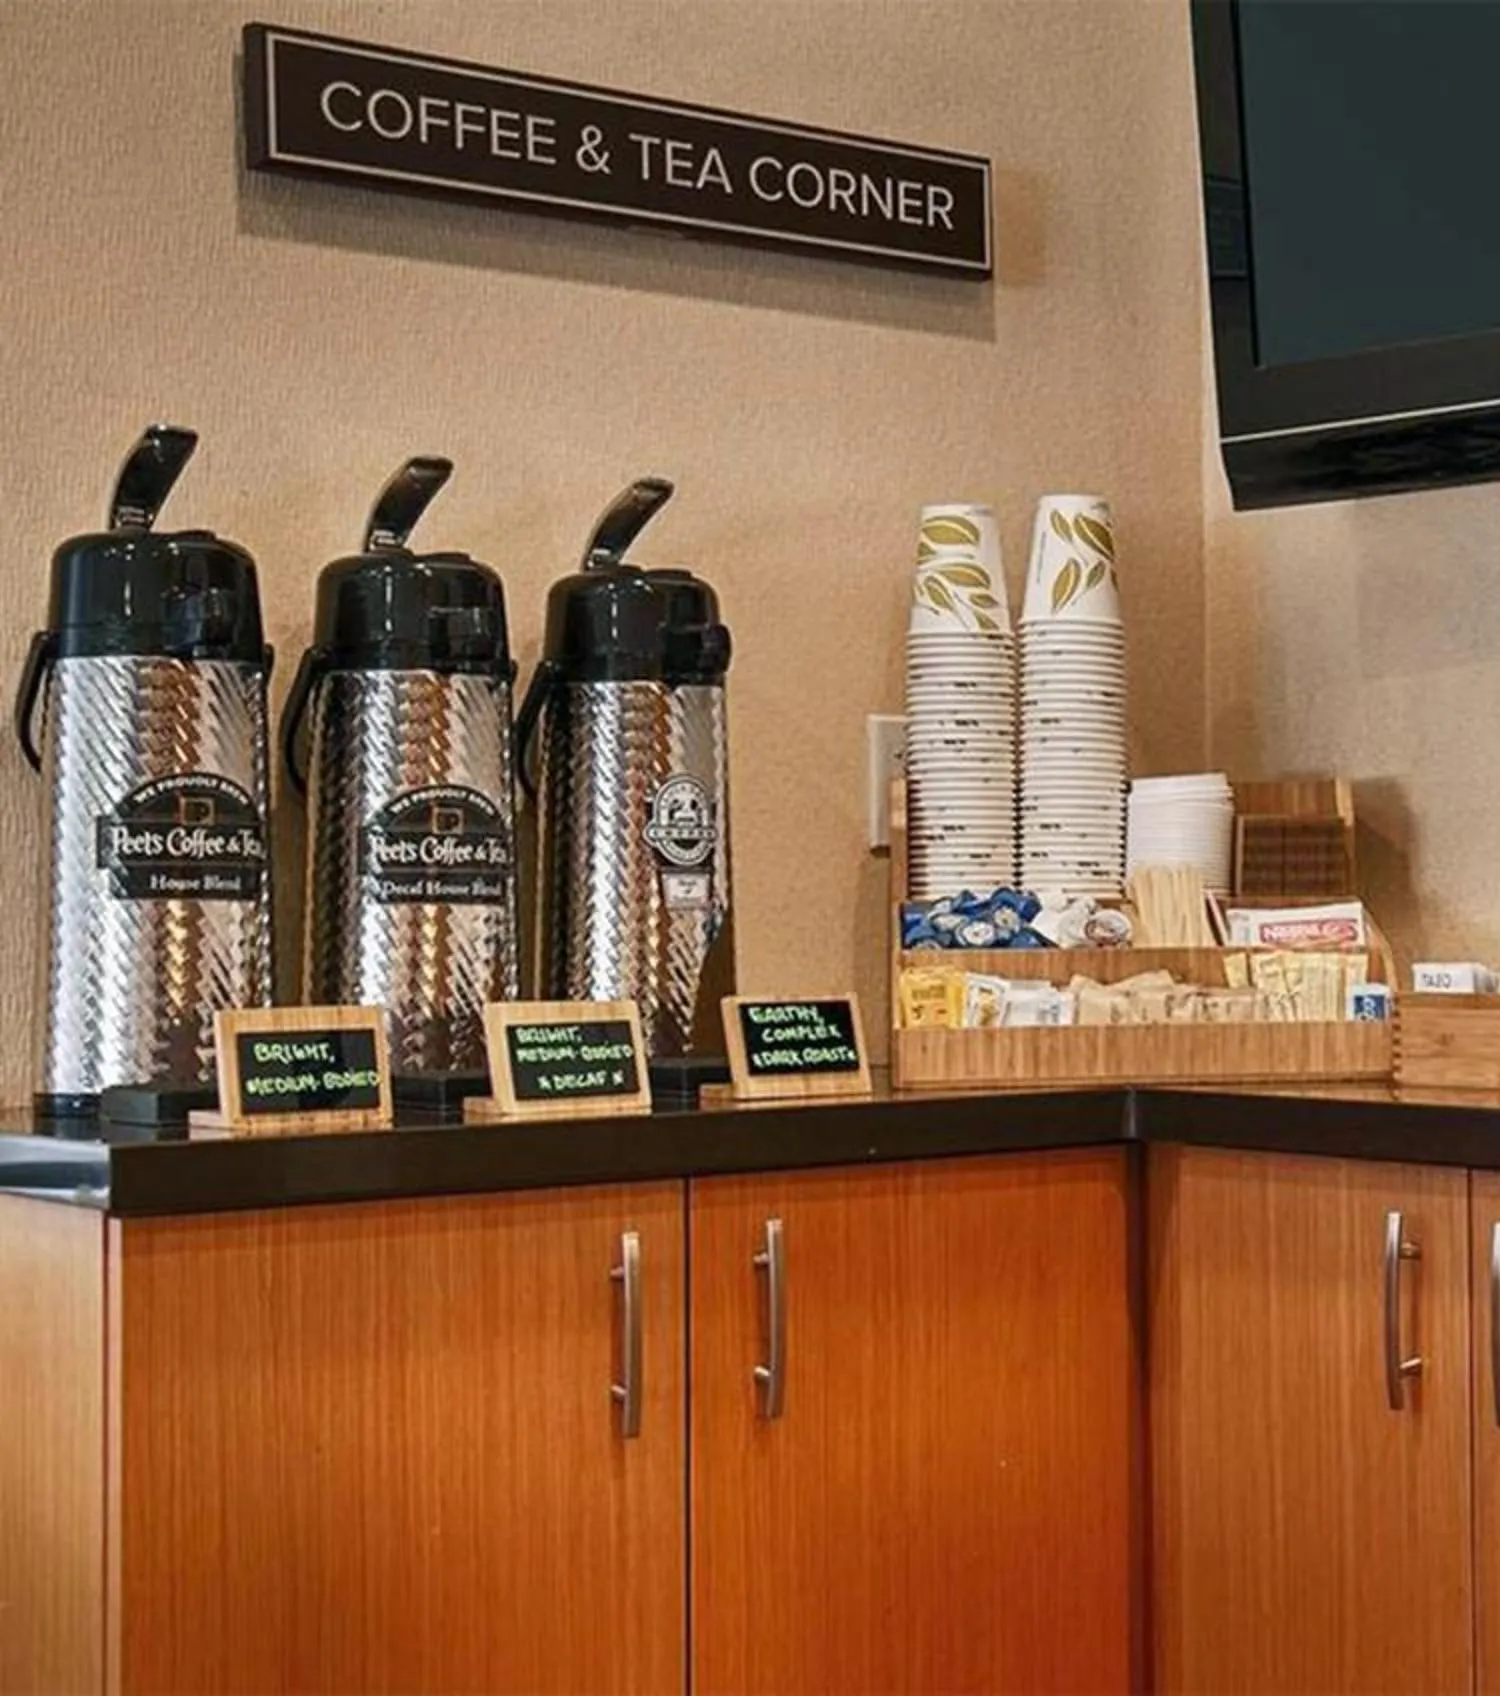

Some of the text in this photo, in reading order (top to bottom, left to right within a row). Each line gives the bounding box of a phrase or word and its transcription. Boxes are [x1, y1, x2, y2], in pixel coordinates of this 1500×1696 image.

[321, 81, 956, 231] COFFEE & TEA CORNER
[166, 827, 226, 859] Coffee
[226, 836, 239, 853] &
[420, 836, 473, 865] Coffee
[474, 846, 486, 861] &
[151, 874, 241, 890] House Blend
[426, 880, 469, 895] House
